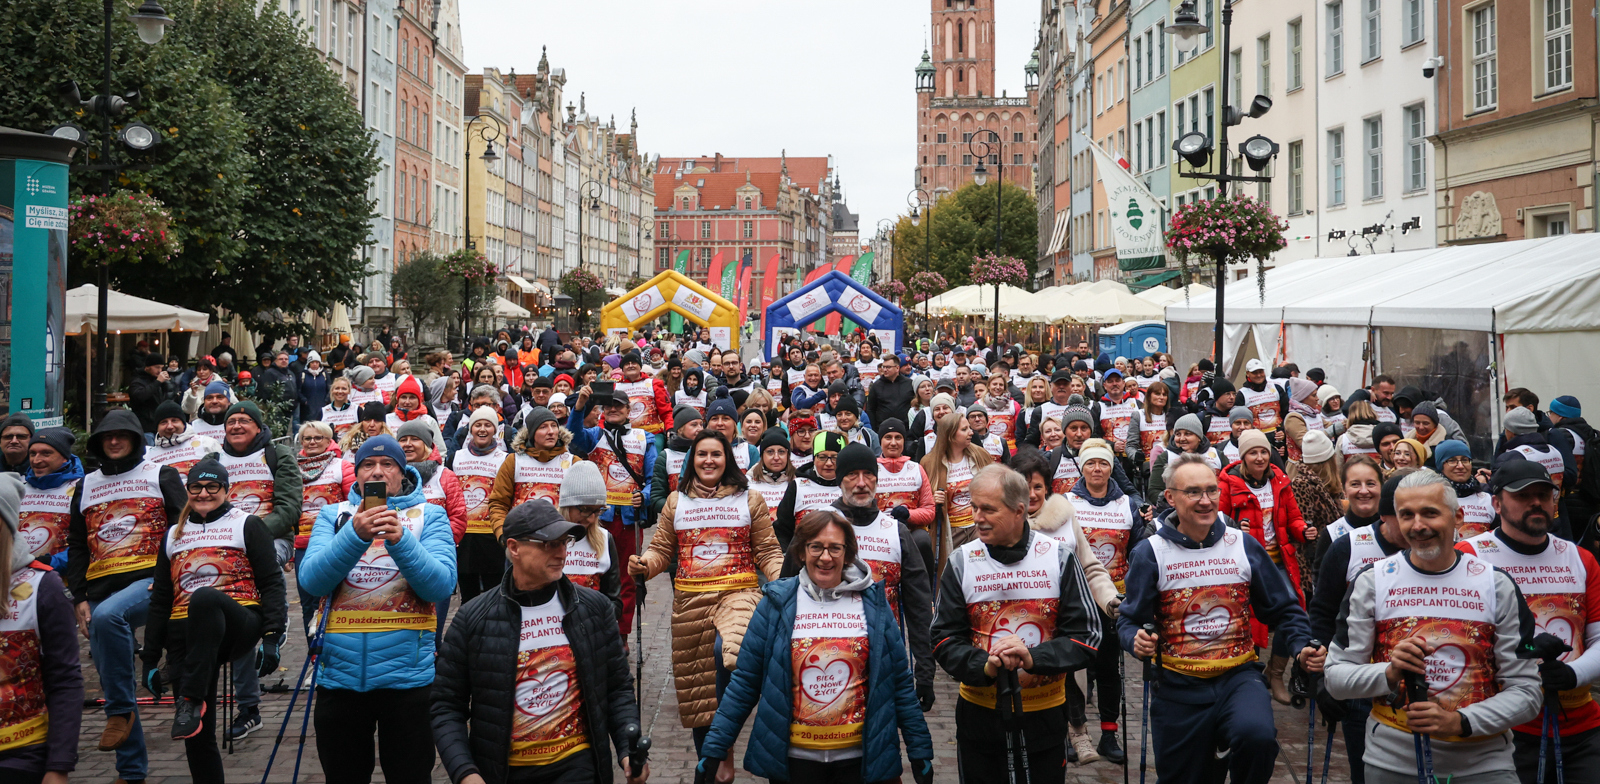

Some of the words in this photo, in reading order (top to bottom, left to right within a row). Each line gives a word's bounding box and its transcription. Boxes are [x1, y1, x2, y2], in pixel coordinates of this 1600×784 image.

[29, 206, 57, 216] Myślisz,
[28, 218, 42, 227] Cię
[1402, 216, 1421, 234] grill
[1116, 223, 1157, 242] HOLENDER
[1119, 246, 1164, 256] RESTAURACJA
[42, 419, 56, 427] może
[91, 482, 120, 493] WSPIERAM
[90, 486, 149, 501] TRANSPLANTOLOGIĘ
[685, 507, 712, 515] WSPIERAM
[175, 534, 233, 547] ANSPLANTOLOGIĘ
[864, 536, 889, 545] POLSKĄ
[858, 544, 891, 554] NTOLOGIĘ
[565, 560, 599, 568] ANTOLOGIĘ
[1166, 560, 1205, 571] WSPIERAM
[1166, 567, 1240, 581] TRANSPLANTOLOGIĘ
[1540, 566, 1571, 574] POLSKĄ
[975, 571, 1013, 582] WSPIERAM
[1016, 570, 1048, 578] POLSKĄ
[1515, 576, 1576, 585] SPLANTOLOGIĘ
[974, 580, 1051, 593] TRANSPLANTOLOGIĘ
[1388, 586, 1438, 596] WSPIERAM
[1442, 587, 1480, 600] POLSKĄ
[1386, 598, 1485, 611] TRANSPLANTOLOGIĘ
[348, 616, 411, 625] października
[521, 617, 543, 629] ERAM
[547, 615, 565, 624] POL
[793, 622, 864, 630] RANSPLANTOLOGIĘ
[1202, 623, 1224, 631] NOWE
[520, 627, 565, 640] SPLANTOL
[821, 680, 842, 689] NOWE
[536, 691, 561, 702] NOWE
[814, 688, 838, 696] ŻYCIE
[1022, 692, 1048, 701] ziernika
[528, 700, 553, 709] ŻYCIE
